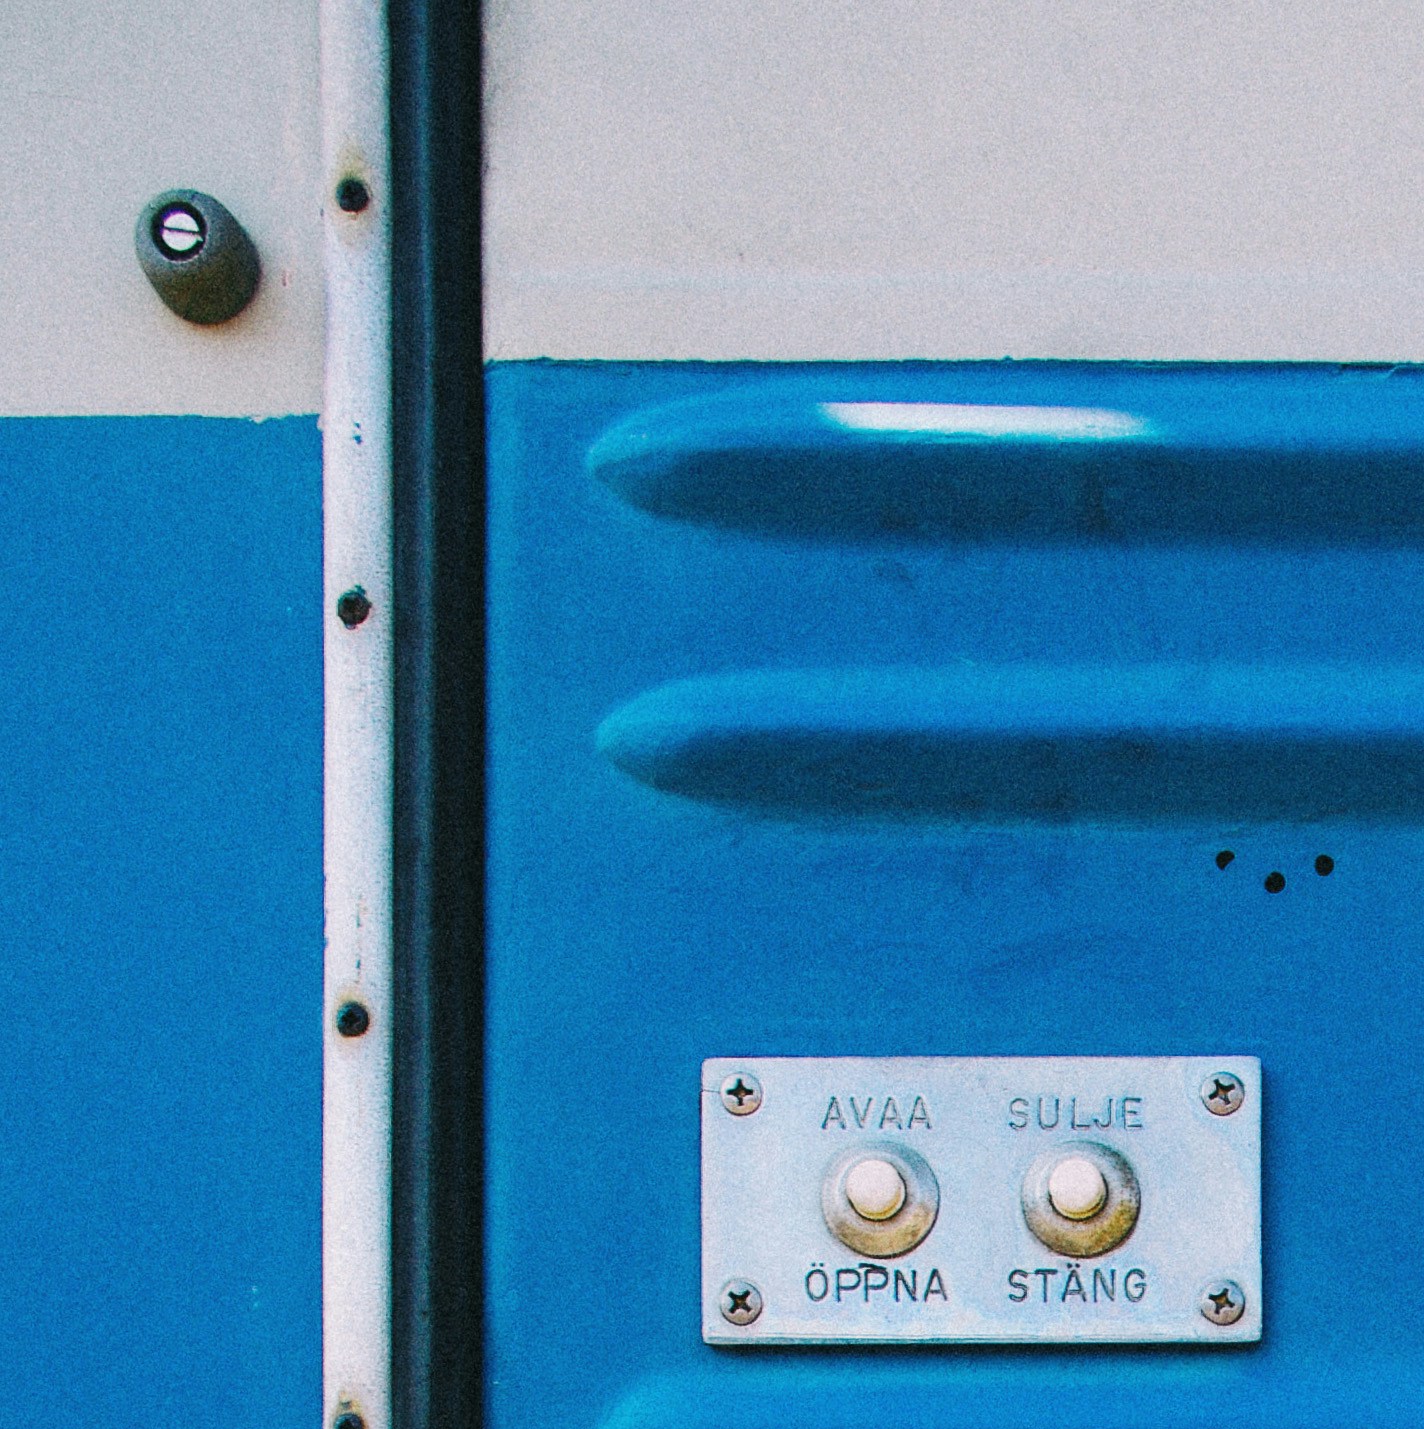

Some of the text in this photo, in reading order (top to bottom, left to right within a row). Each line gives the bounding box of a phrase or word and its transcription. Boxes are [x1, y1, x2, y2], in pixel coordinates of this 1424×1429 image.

[821, 1096, 933, 1130] AVAA
[1008, 1097, 1144, 1130] SULJE
[804, 1262, 948, 1302] ÖPPNA
[1008, 1262, 1147, 1302] STÄNG
